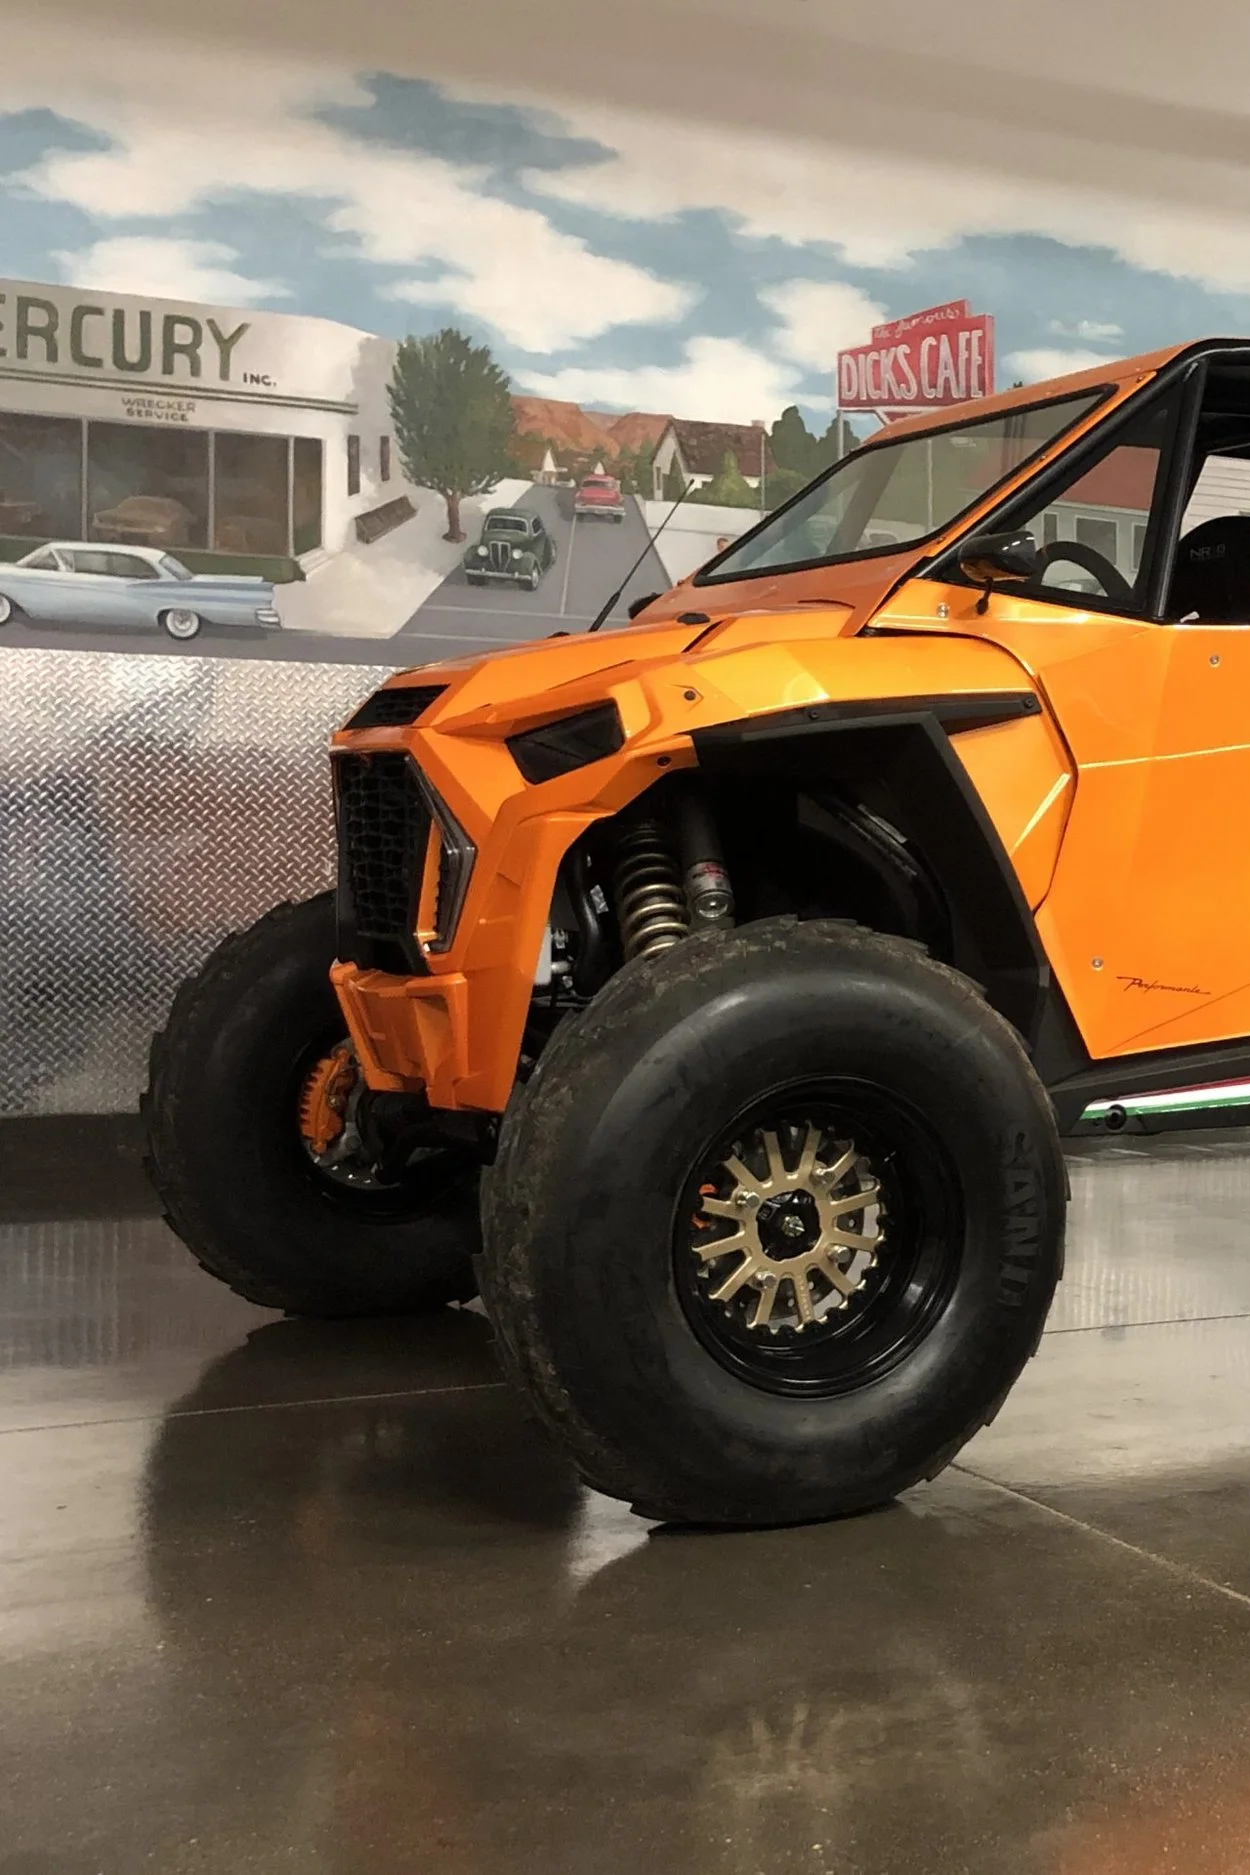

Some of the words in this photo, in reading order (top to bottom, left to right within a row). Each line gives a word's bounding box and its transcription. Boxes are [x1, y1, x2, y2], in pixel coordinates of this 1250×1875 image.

[0, 293, 251, 382] RCURY
[243, 372, 277, 387] INC.
[841, 344, 918, 401] DICKS
[919, 329, 984, 399] CAFE
[121, 397, 196, 413] WRECKER
[126, 407, 189, 422] SERVICE
